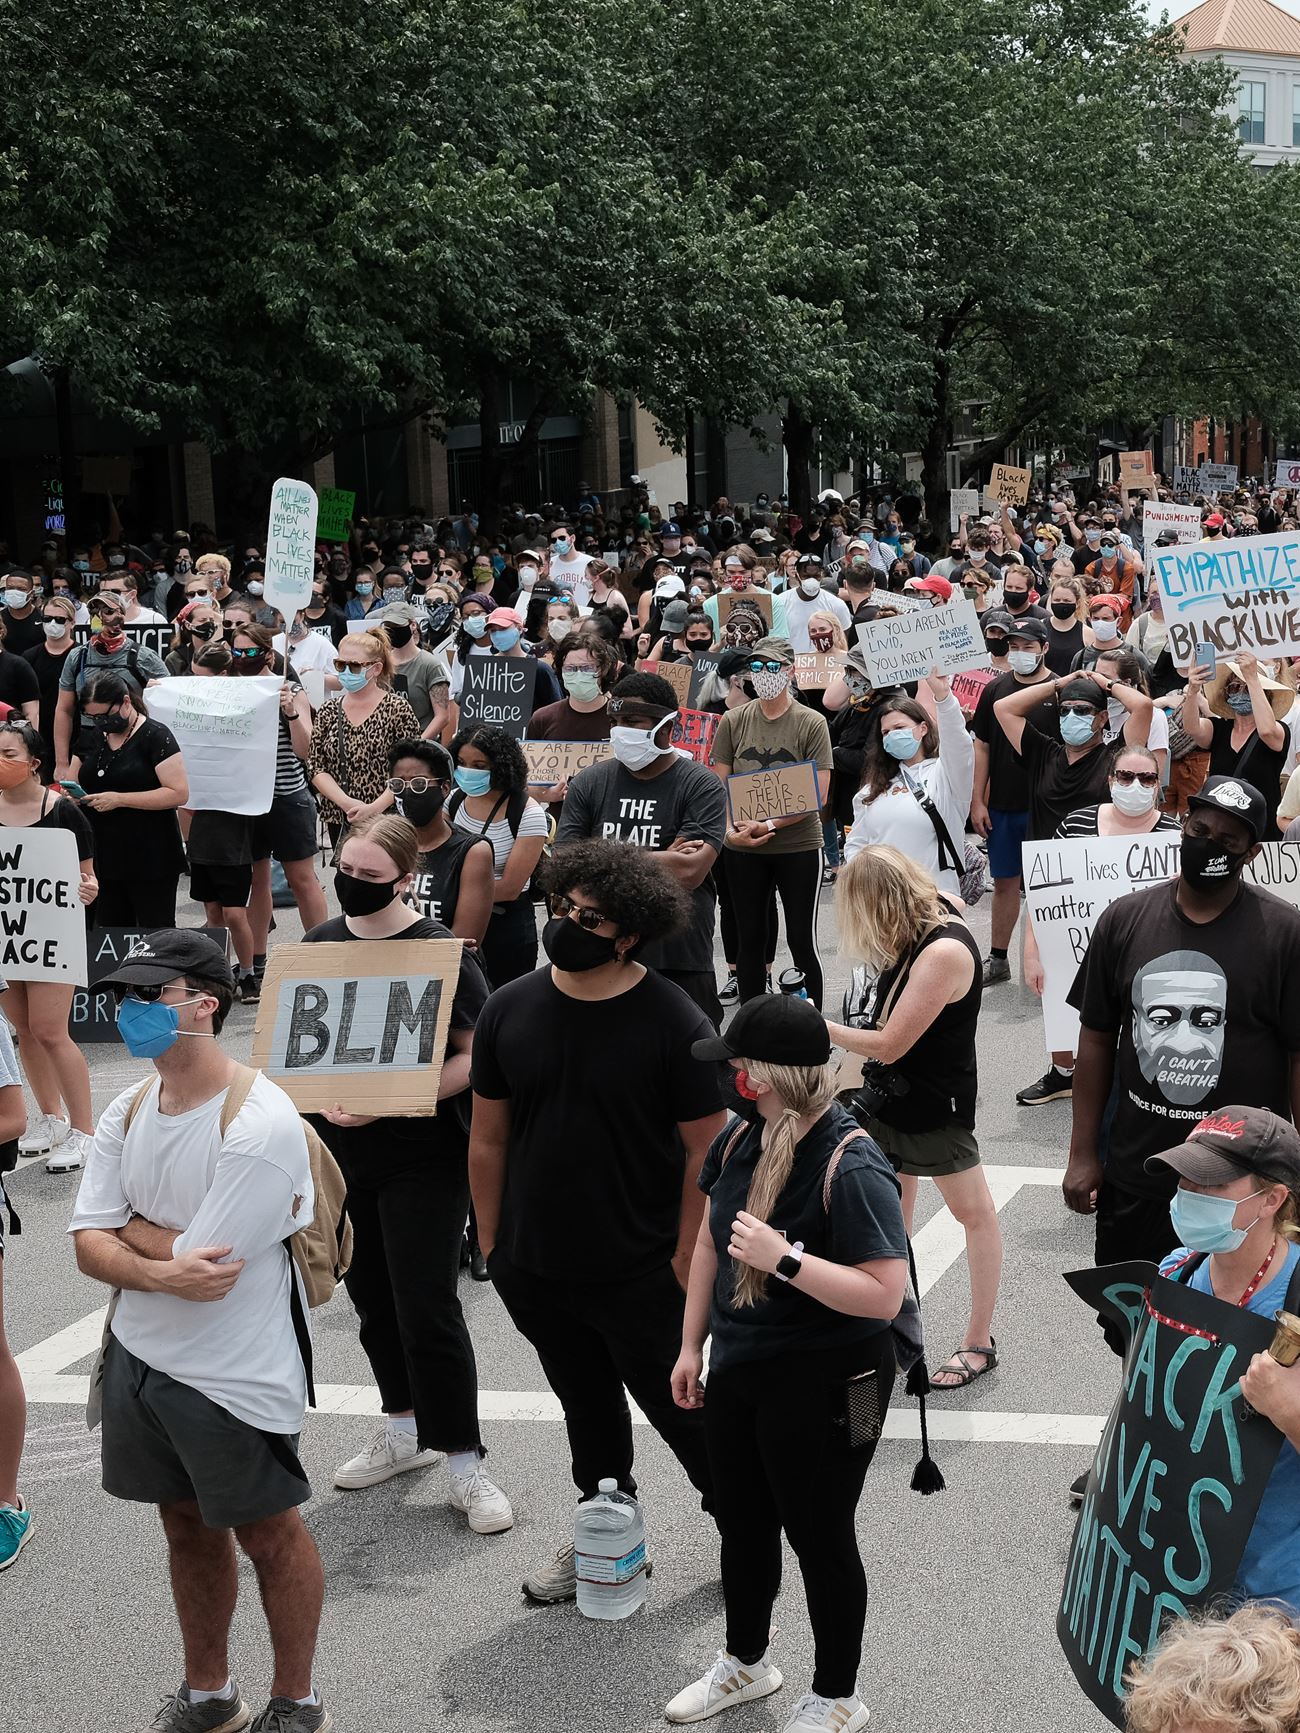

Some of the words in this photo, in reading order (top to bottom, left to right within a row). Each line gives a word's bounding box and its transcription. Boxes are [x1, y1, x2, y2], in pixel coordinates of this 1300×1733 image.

[273, 513, 299, 525] WHEN
[272, 524, 311, 541] BLACK
[276, 541, 312, 563] LIVES
[268, 557, 311, 581] MATTER
[866, 626, 878, 639] IF
[885, 619, 912, 636] YOU
[915, 608, 956, 633] AREN'T
[658, 665, 691, 680] BLACK
[872, 655, 900, 671] YOU
[877, 666, 929, 685] LISTENING
[463, 694, 522, 722] Silence
[543, 743, 574, 753] ARE
[583, 743, 610, 753] THE
[752, 770, 782, 789] SAY
[747, 784, 793, 803] THEIR
[619, 798, 658, 820] THE
[739, 795, 807, 821] NAMES
[602, 825, 662, 847] PLATE
[1029, 851, 1074, 886] ALL
[1085, 849, 1119, 881] lives
[1035, 894, 1095, 922] matter
[285, 979, 443, 1068] BLM
[1158, 1055, 1165, 1066] I
[1168, 1056, 1216, 1072] CAN'T
[1156, 1070, 1219, 1088] BREATHE
[1151, 1103, 1167, 1117] FOR
[1168, 1108, 1209, 1120] GEORGE
